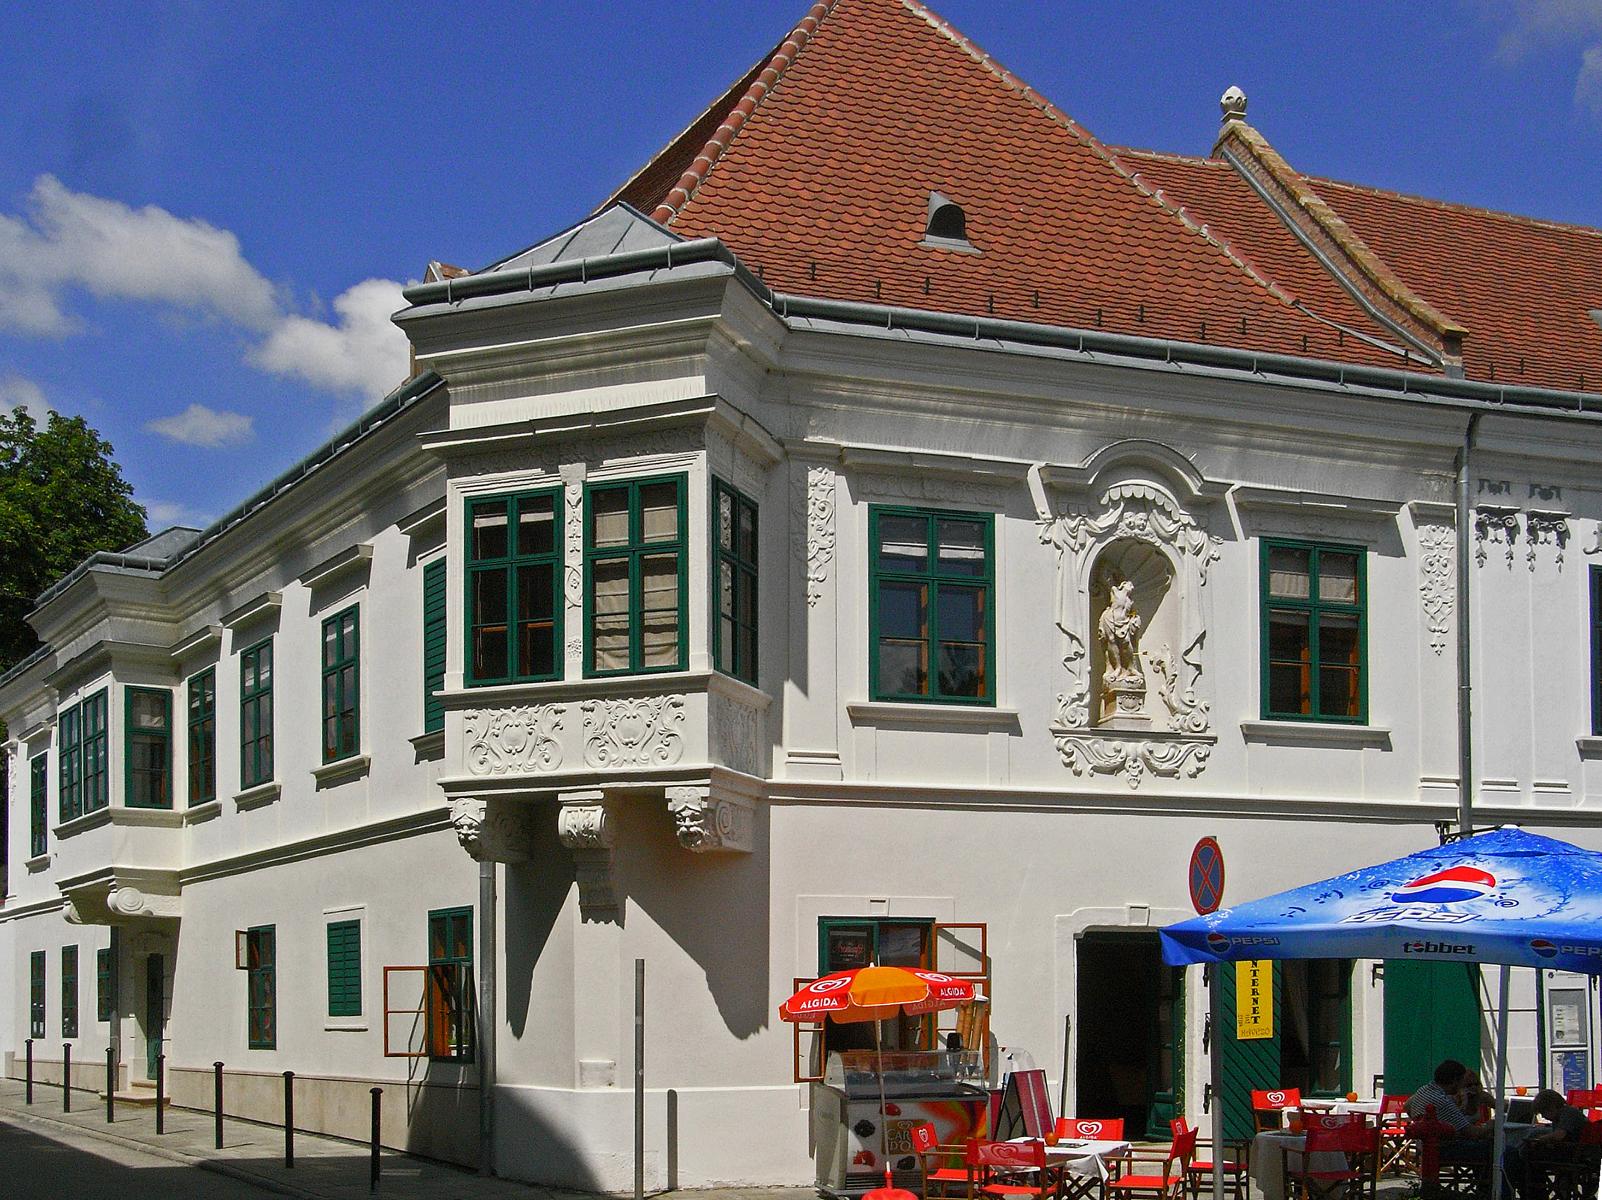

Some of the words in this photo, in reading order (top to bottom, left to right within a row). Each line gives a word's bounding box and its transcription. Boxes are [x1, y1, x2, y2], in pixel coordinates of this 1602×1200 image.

[1341, 908, 1481, 923] PEPSI
[1231, 937, 1279, 945] PEPSI
[1561, 946, 1602, 957] PEP
[940, 987, 965, 996] ALGIDA
[1250, 960, 1260, 1024] NTERNET
[800, 997, 838, 1009] ALGIDA
[888, 1129, 912, 1142] CAR
